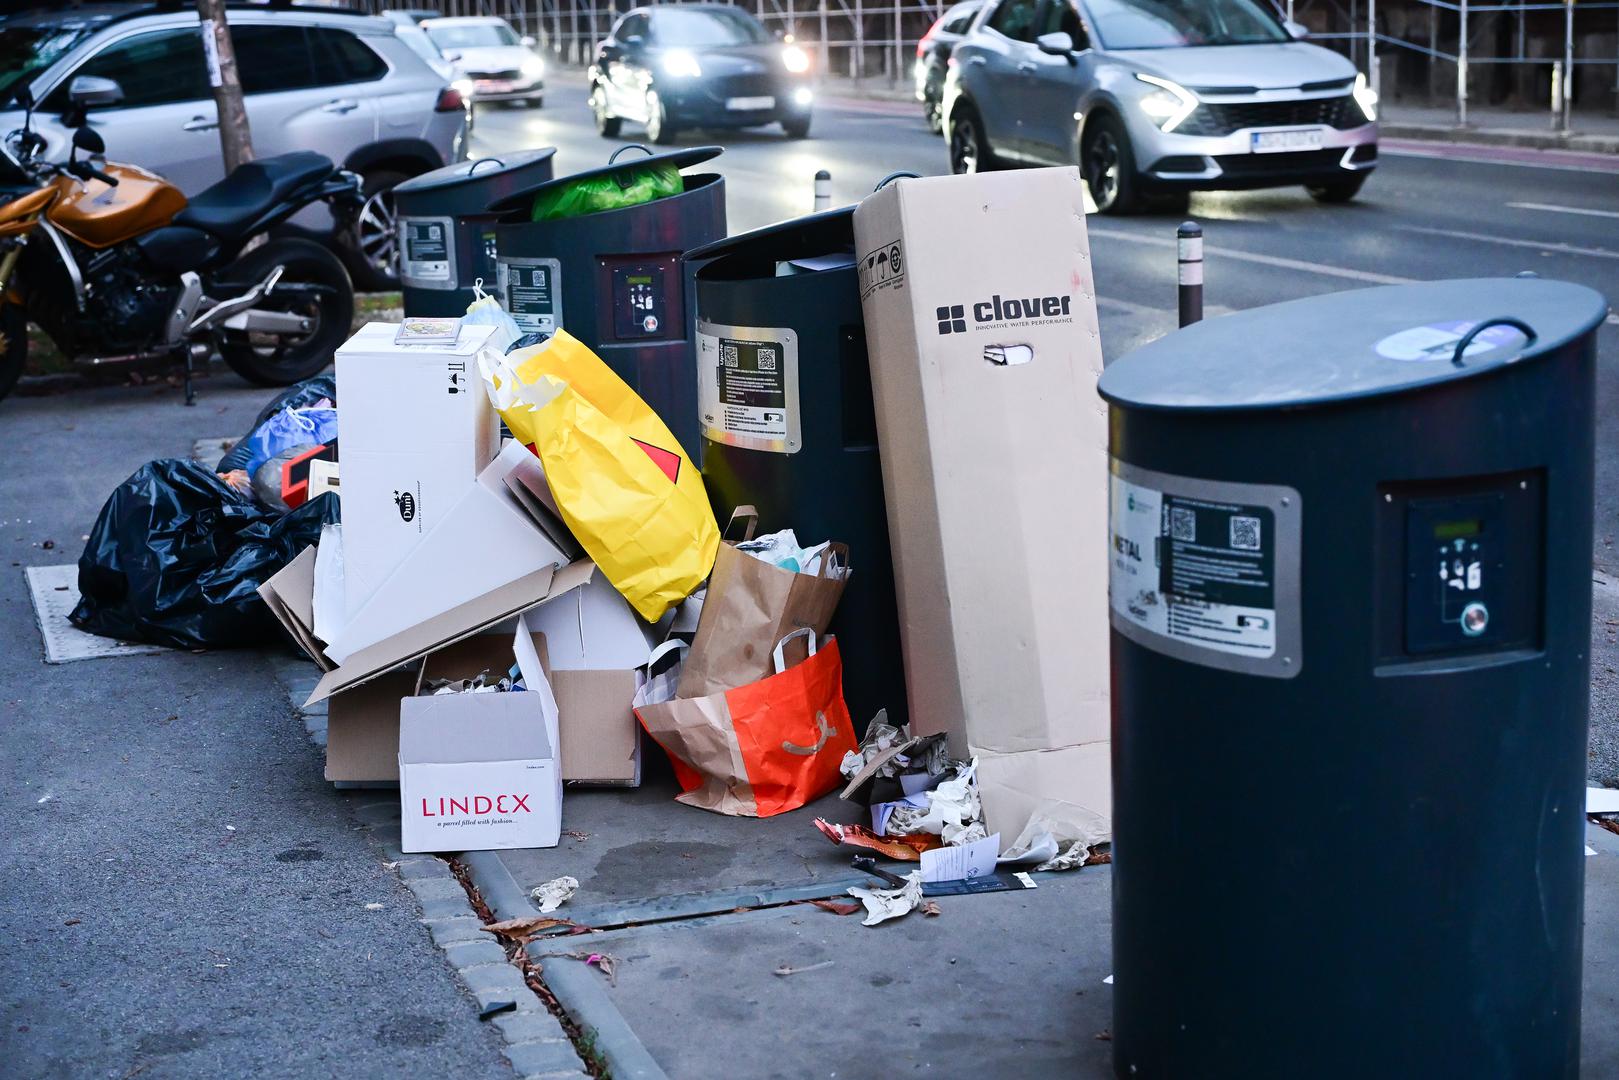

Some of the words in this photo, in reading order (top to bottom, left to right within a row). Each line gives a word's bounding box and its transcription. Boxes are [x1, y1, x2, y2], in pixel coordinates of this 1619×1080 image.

[974, 295, 1071, 322] clover
[976, 323, 1009, 331] INNOVATIVE
[1010, 321, 1029, 329] WATER
[1031, 317, 1073, 326] PERFORMANCE
[403, 495, 411, 518] Duni
[422, 794, 531, 817] LINDEX
[443, 820, 461, 828] parcel
[461, 818, 476, 828] filled
